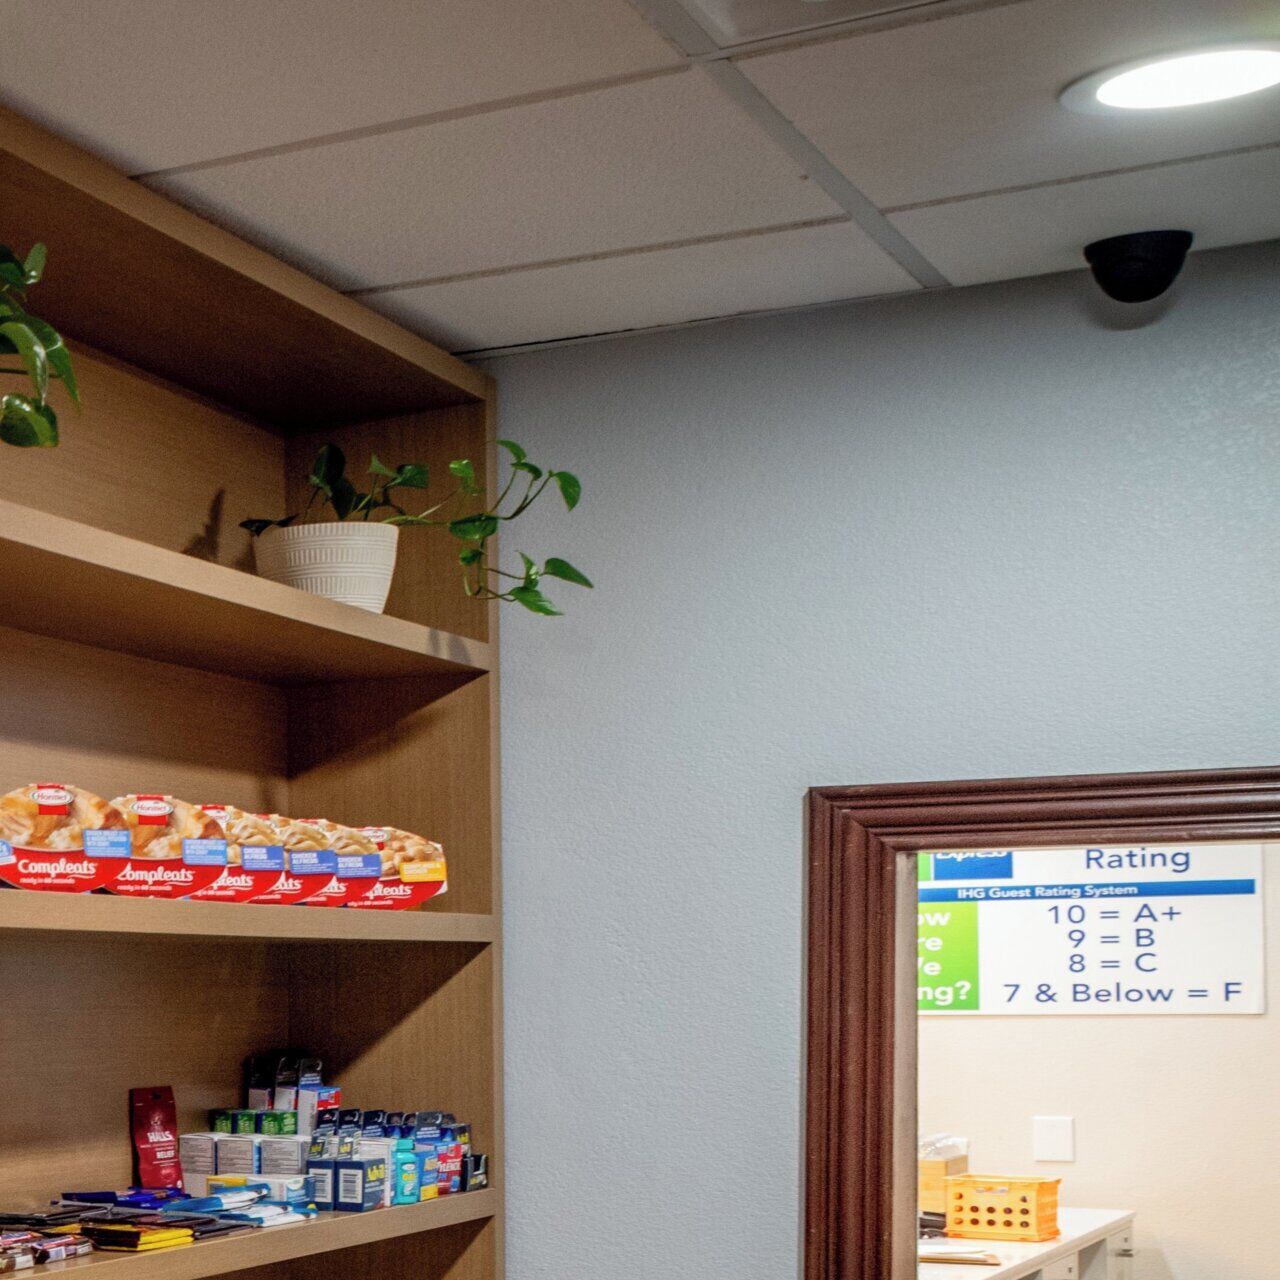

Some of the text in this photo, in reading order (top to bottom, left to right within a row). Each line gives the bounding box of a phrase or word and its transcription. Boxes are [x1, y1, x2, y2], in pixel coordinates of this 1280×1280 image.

[18, 858, 96, 877] Compleats
[1086, 849, 1190, 873] Rating
[957, 885, 1138, 899] IHG Guest Rating System
[918, 911, 950, 926] ow
[1048, 905, 1085, 924] 10
[1134, 904, 1181, 923] A+
[1068, 930, 1085, 948] 9
[1136, 928, 1155, 947] B
[1069, 954, 1086, 972] 8
[1135, 953, 1157, 972] C
[1004, 984, 1020, 1003] 7
[1035, 984, 1057, 1003] &
[1072, 982, 1174, 1003] Below
[1224, 983, 1242, 1001] F
[148, 1132, 173, 1142] HALLS
